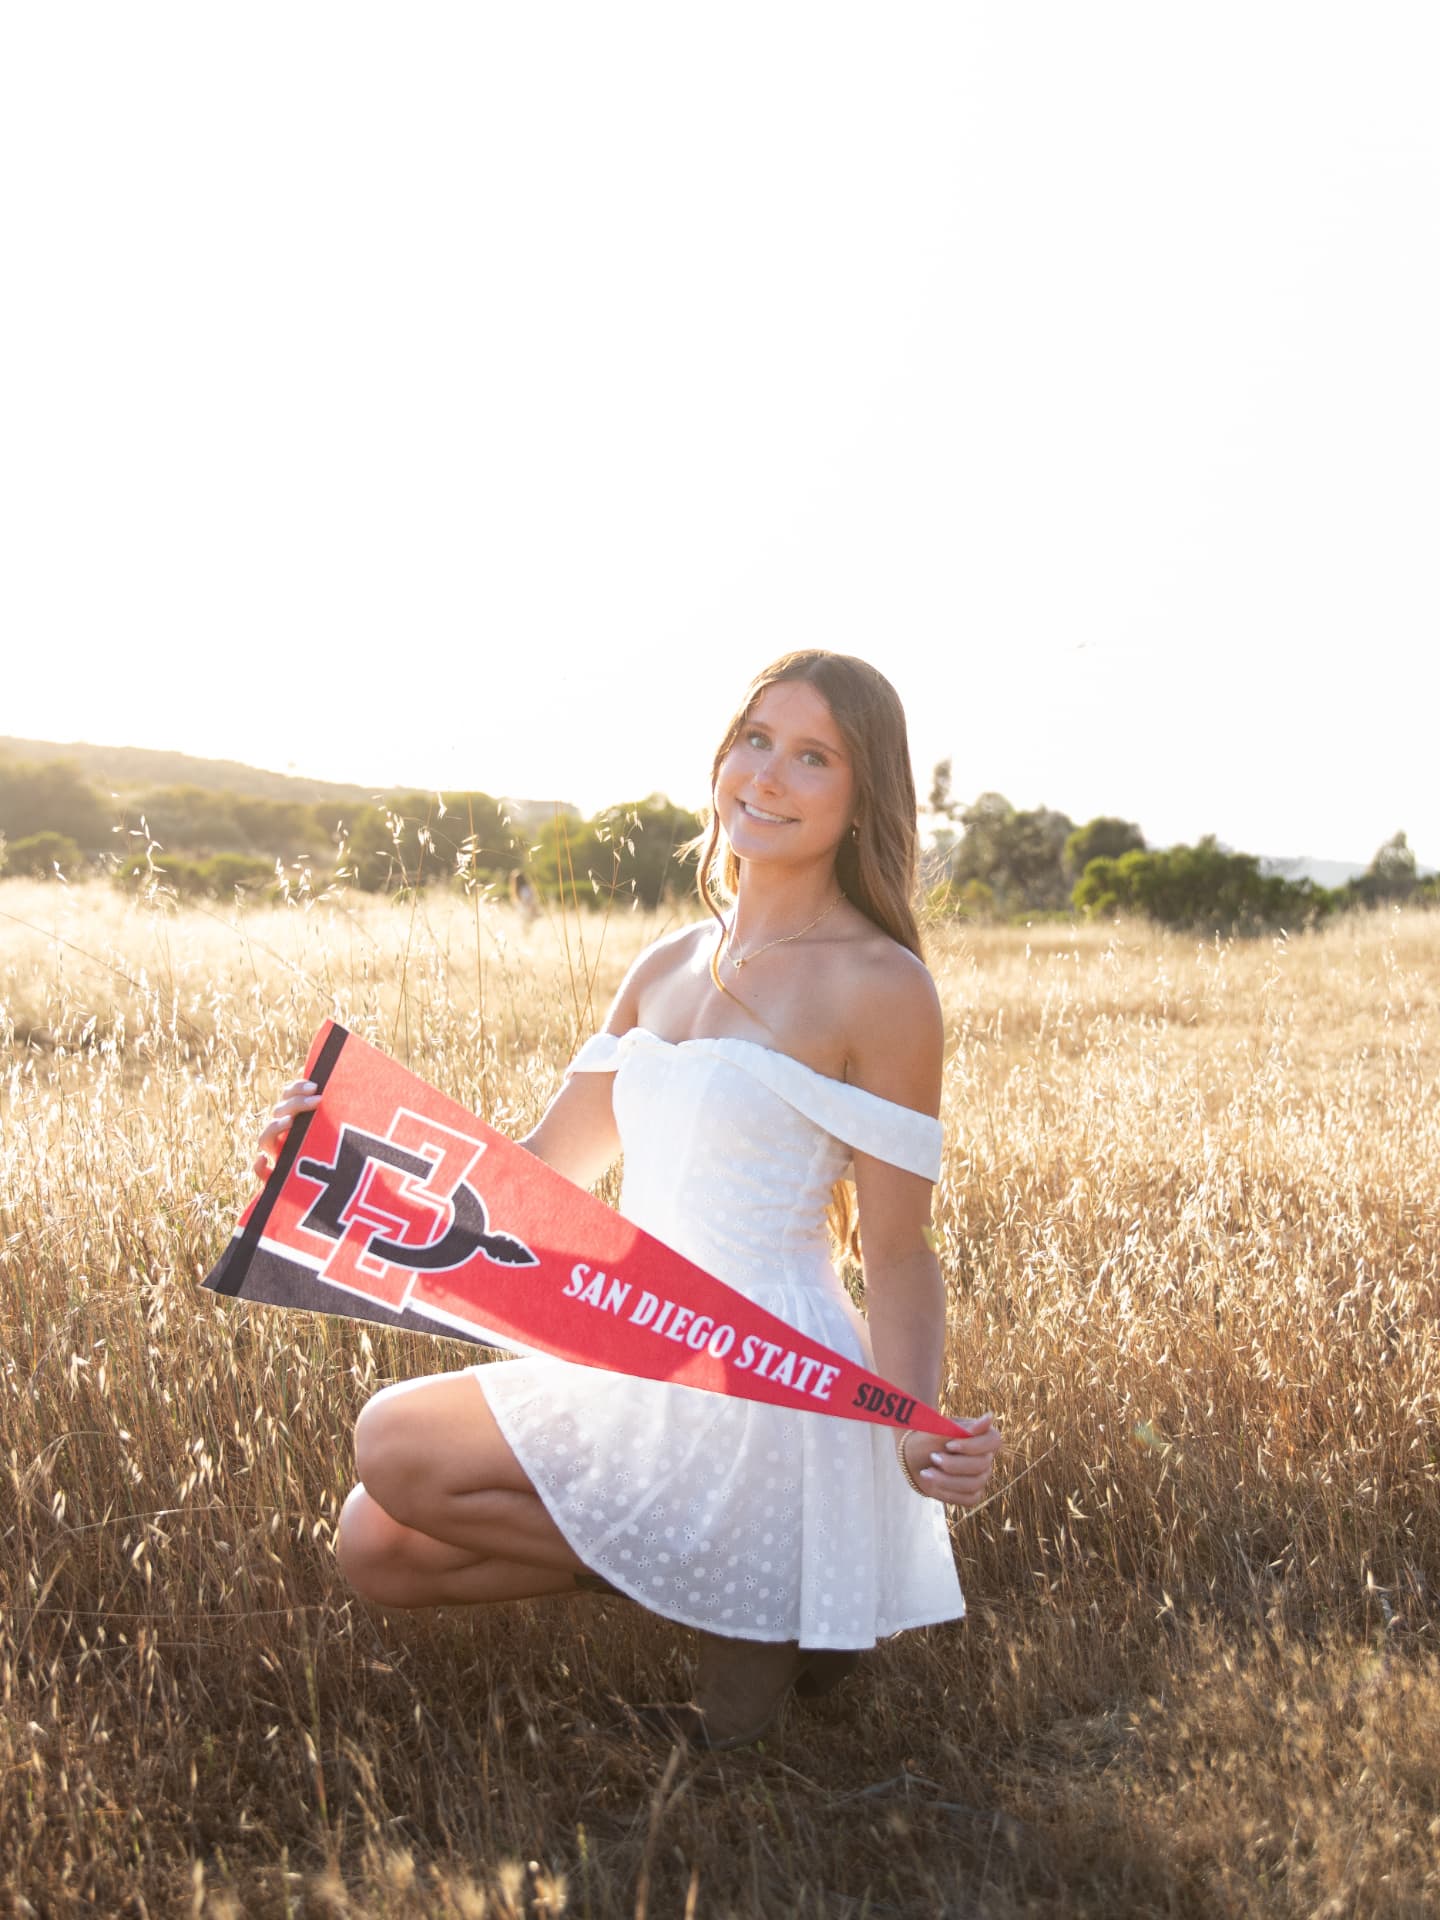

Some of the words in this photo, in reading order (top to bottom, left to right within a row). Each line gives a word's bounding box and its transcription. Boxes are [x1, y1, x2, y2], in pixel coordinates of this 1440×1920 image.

[562, 1263, 632, 1317] SAN
[628, 1290, 736, 1359] DIEGO
[734, 1335, 841, 1400] STATE
[852, 1382, 917, 1425] SDSU
